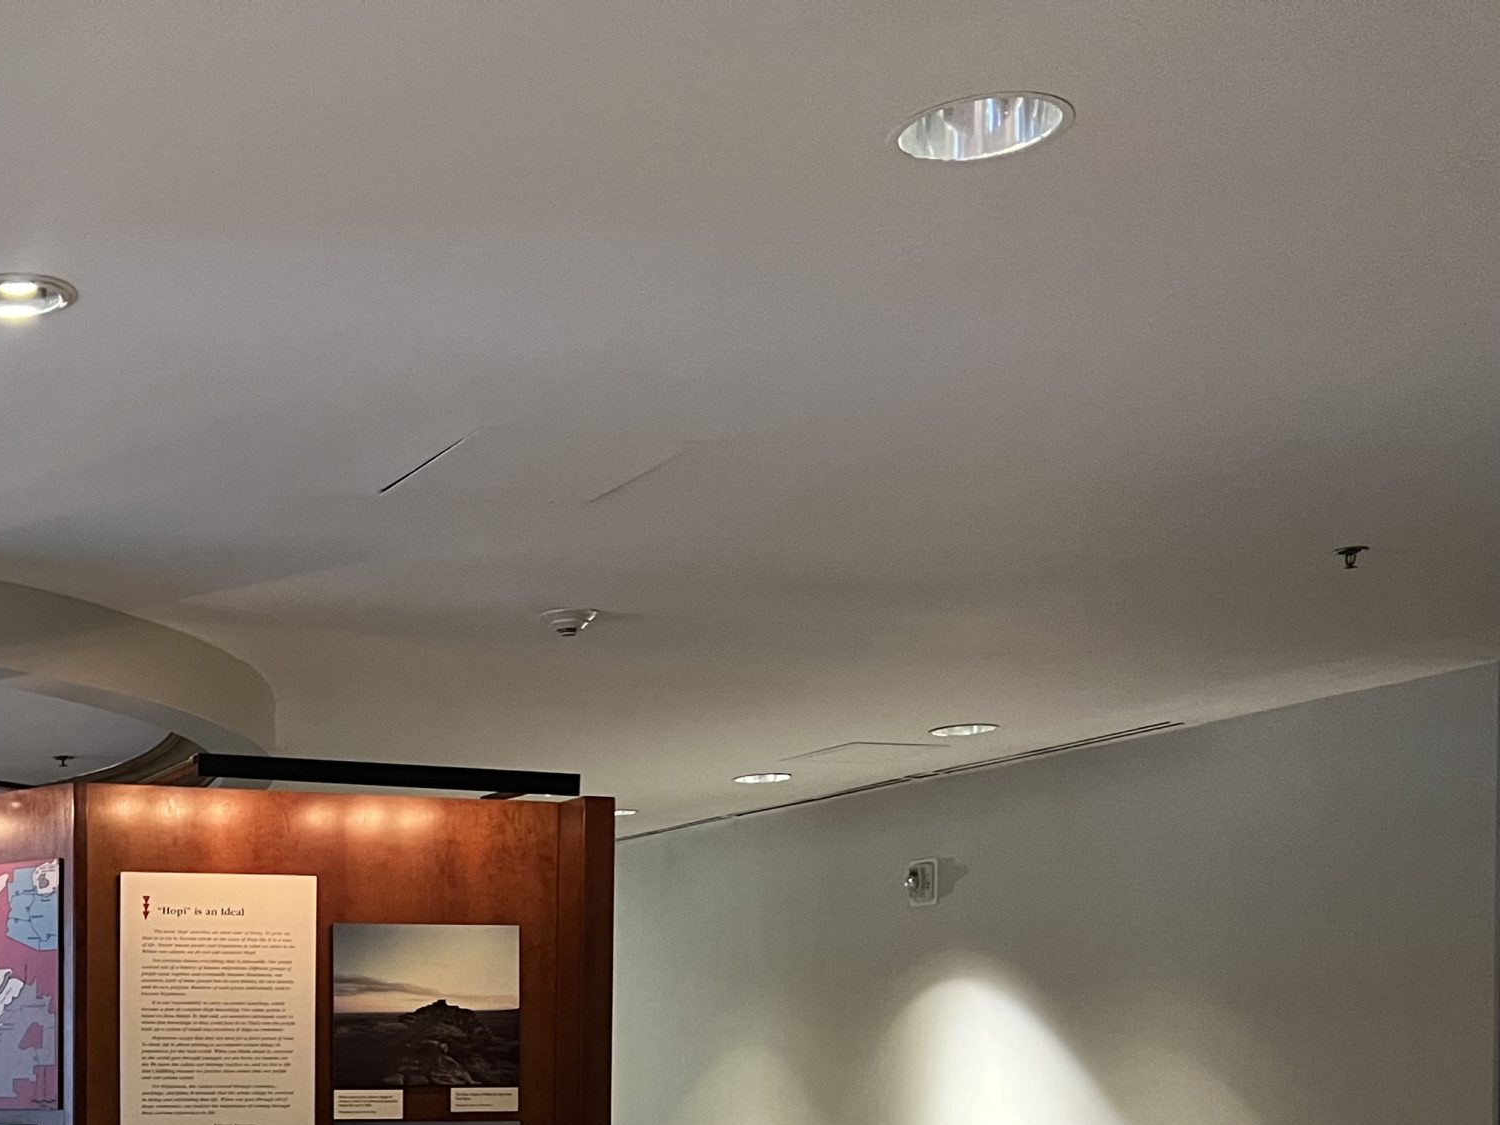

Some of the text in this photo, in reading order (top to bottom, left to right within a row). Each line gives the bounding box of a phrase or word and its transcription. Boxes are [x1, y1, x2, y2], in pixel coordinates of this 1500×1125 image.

[194, 906, 202, 916] is
[205, 908, 218, 916] an
[221, 907, 245, 916] Ideal
